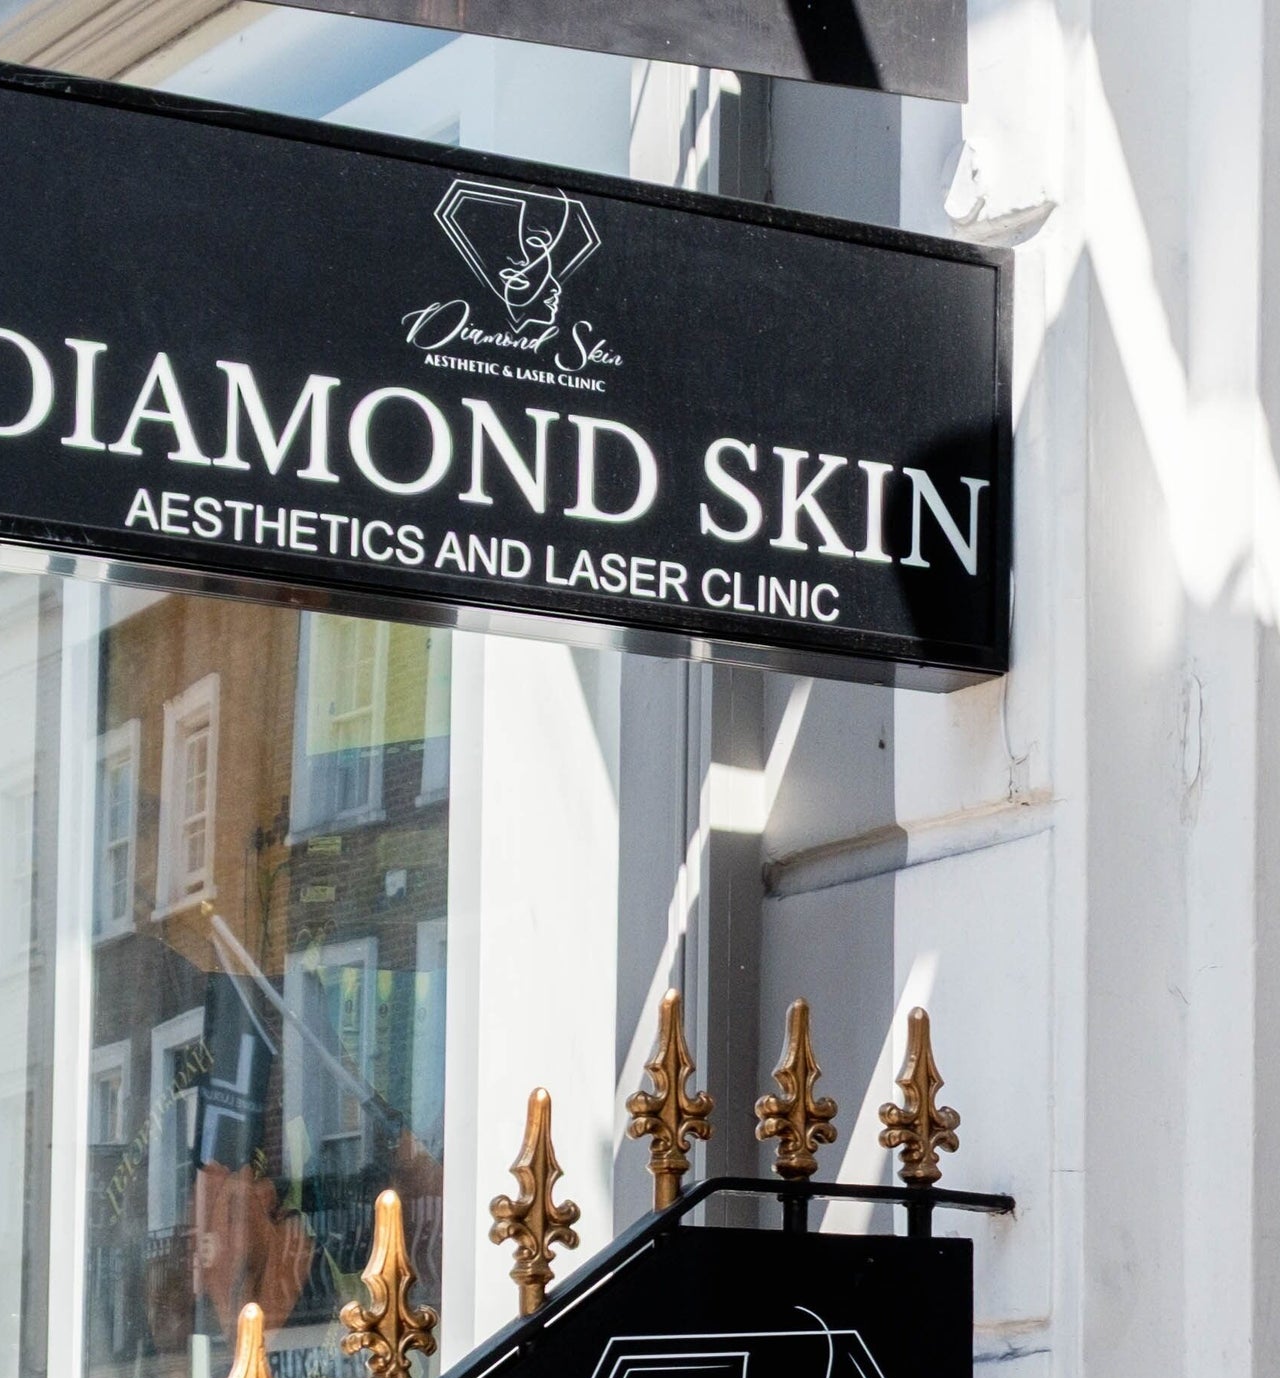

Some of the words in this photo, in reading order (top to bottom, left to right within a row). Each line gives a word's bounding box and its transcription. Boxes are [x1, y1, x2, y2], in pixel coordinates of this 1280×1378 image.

[401, 299, 560, 354] Diamond
[555, 320, 624, 372] Skin
[424, 354, 500, 376] AESTHETIC
[502, 364, 514, 378] &
[516, 367, 556, 385] LASER
[557, 373, 607, 393] CLINIC
[124, 485, 424, 567] AESTHETICS
[434, 531, 532, 579] AND
[545, 544, 689, 603] LASER
[701, 568, 841, 622] CLINIC
[699, 437, 990, 577] SKIN
